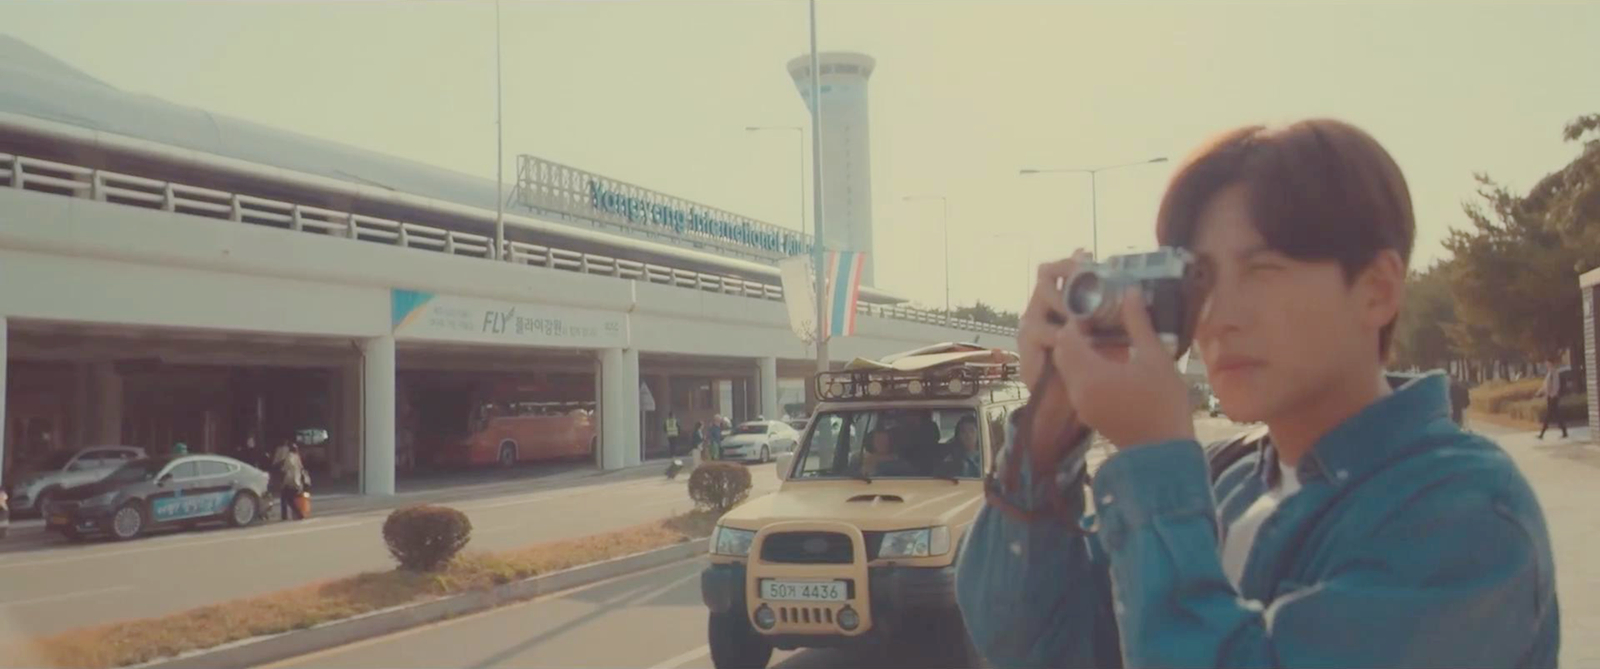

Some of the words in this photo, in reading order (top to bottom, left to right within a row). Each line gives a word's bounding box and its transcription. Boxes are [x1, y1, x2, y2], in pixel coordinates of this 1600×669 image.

[588, 180, 687, 233] Yangyang
[688, 207, 780, 251] International
[482, 306, 515, 334] FLY
[801, 585, 838, 599] 4436
